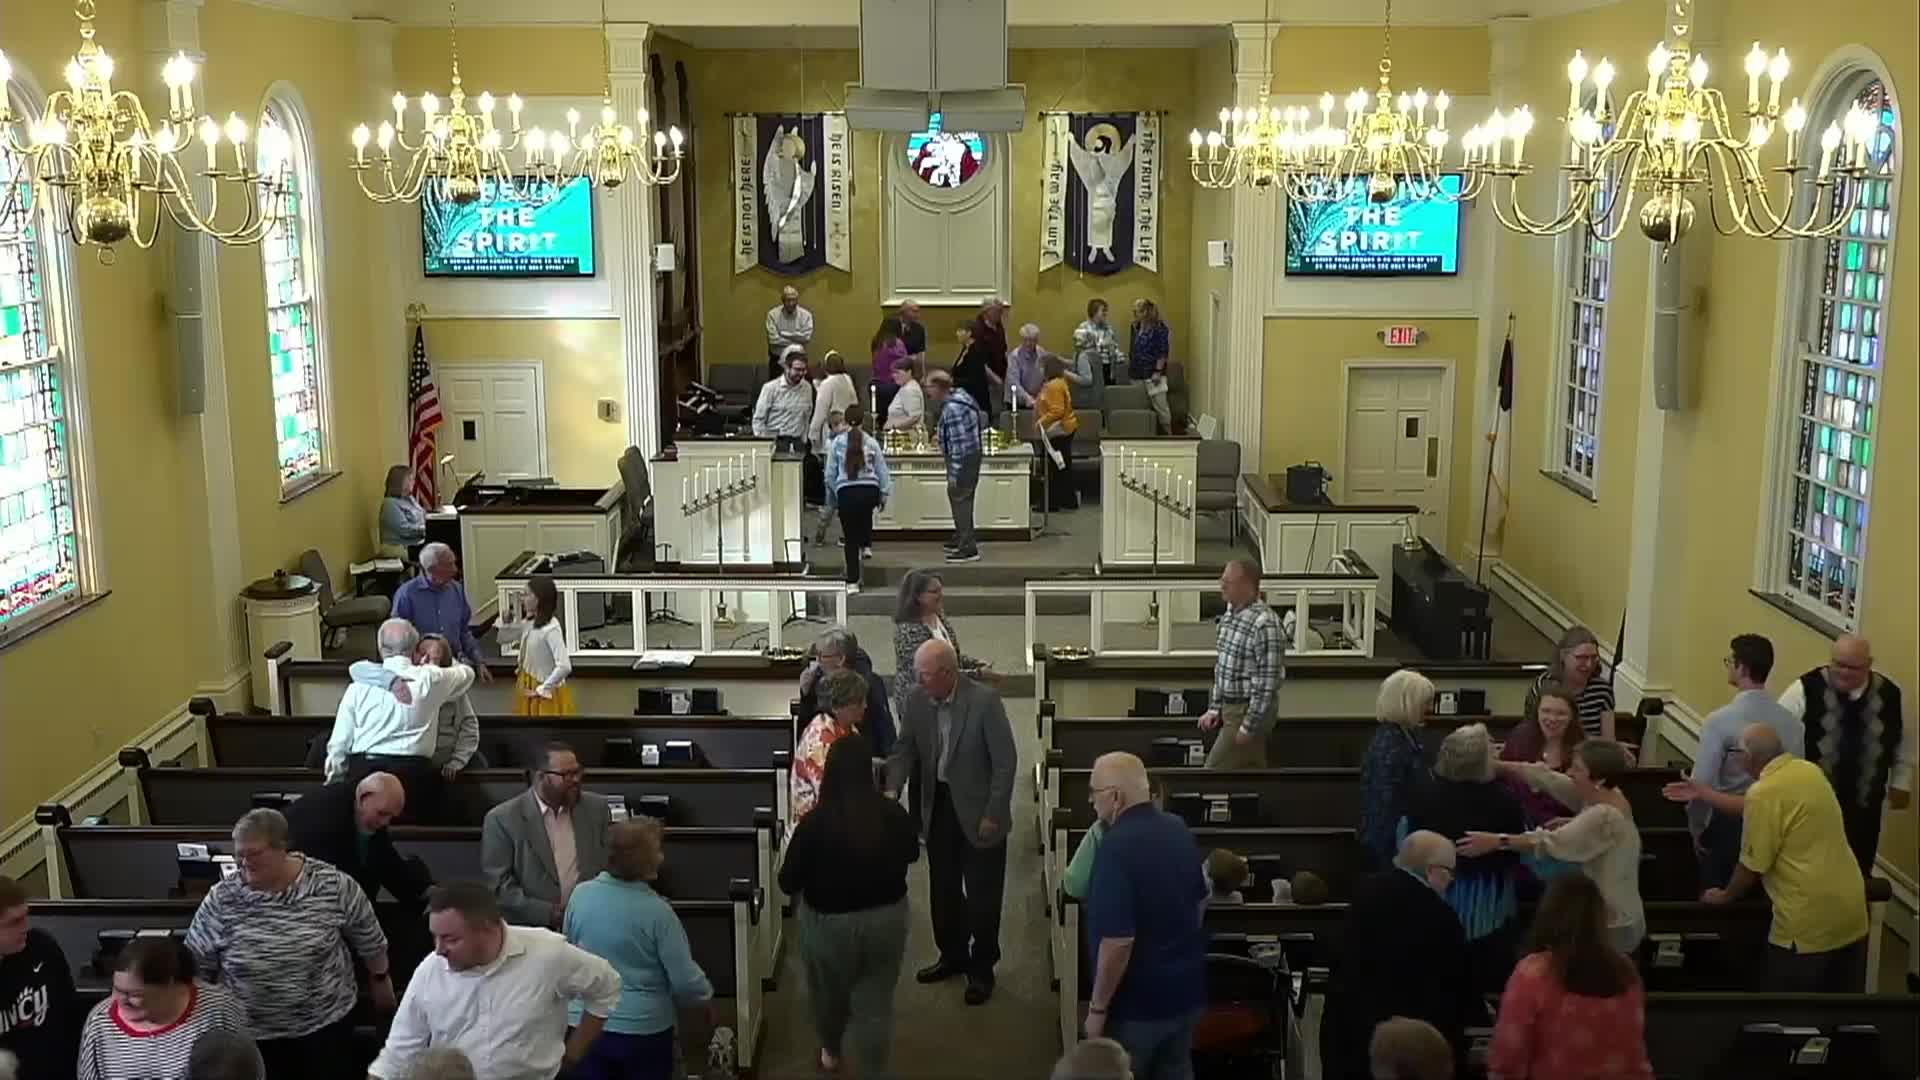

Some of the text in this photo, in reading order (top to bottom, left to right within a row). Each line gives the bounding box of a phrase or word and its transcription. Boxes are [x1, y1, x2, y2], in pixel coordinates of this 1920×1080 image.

[476, 207, 536, 227] THE
[1345, 206, 1401, 227] THE
[455, 231, 556, 252] SPIRIT
[1319, 231, 1423, 251] SPIRIT
[1390, 327, 1416, 344] EXIT
